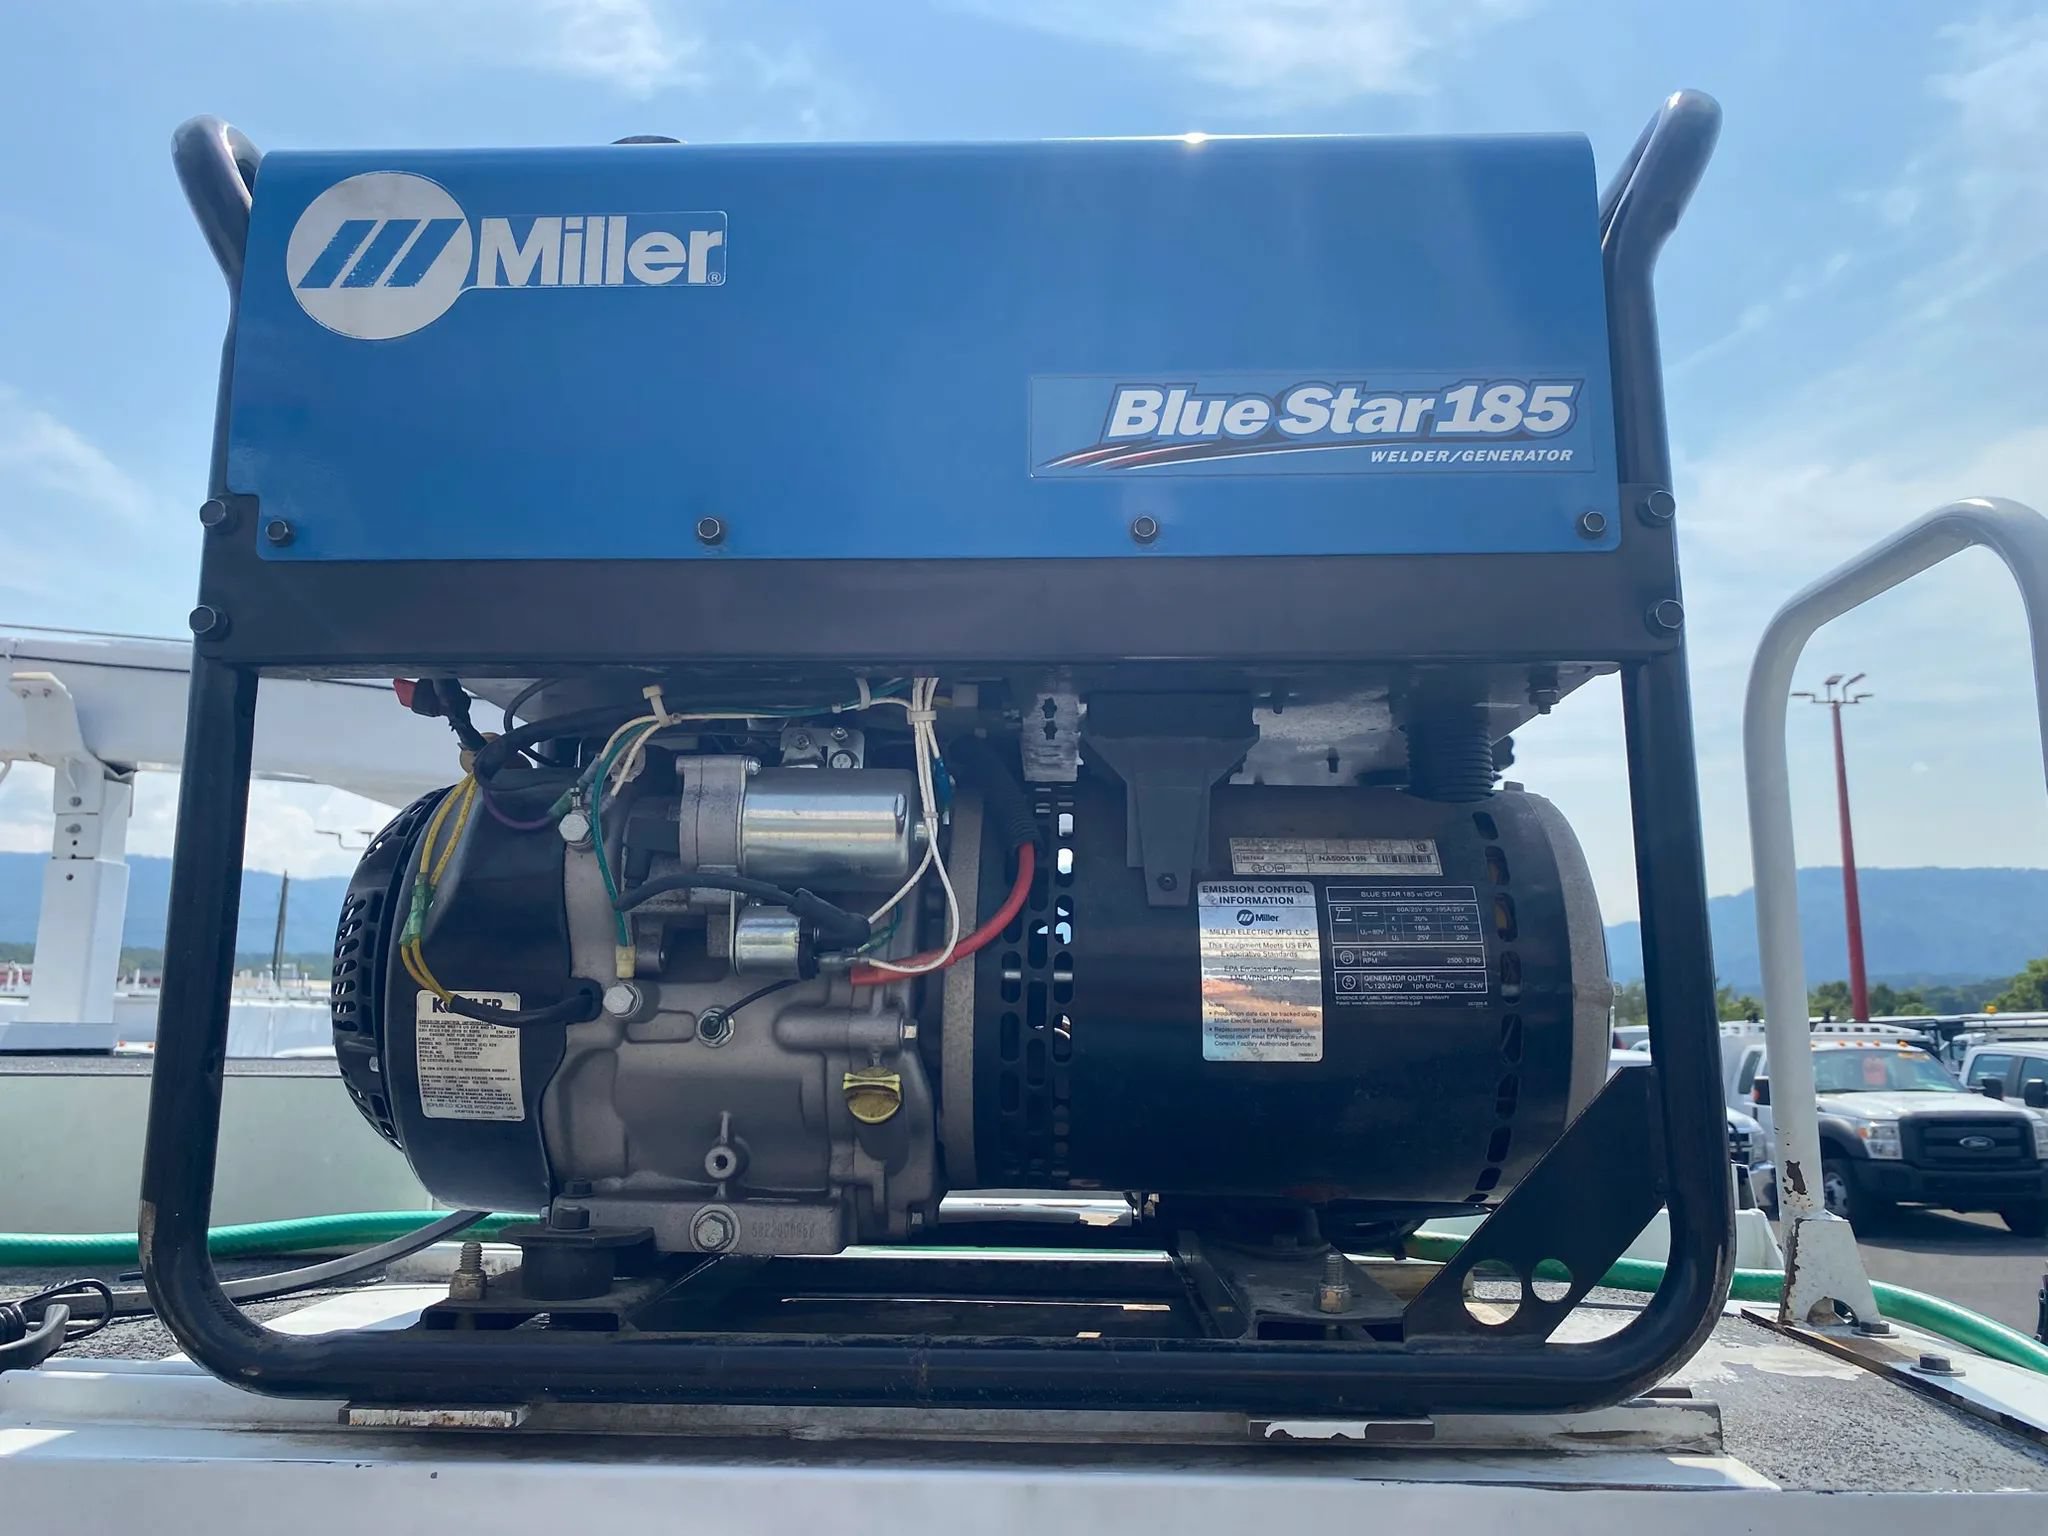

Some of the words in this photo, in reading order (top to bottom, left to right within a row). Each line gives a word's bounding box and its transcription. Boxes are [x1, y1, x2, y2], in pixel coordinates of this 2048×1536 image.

[477, 215, 724, 287] Miller
[1108, 389, 1269, 438] Blue
[1279, 387, 1435, 435] Star
[1436, 383, 1574, 433] 185
[1371, 450, 1573, 463] WELDER/GENERATOR
[1202, 885, 1254, 894] EMISSION
[1257, 885, 1309, 894] CONTROL
[1219, 896, 1294, 905] INFORMATION
[1255, 913, 1279, 922] Miller
[1224, 942, 1261, 950] Equipment
[1221, 951, 1261, 959] Evaporative
